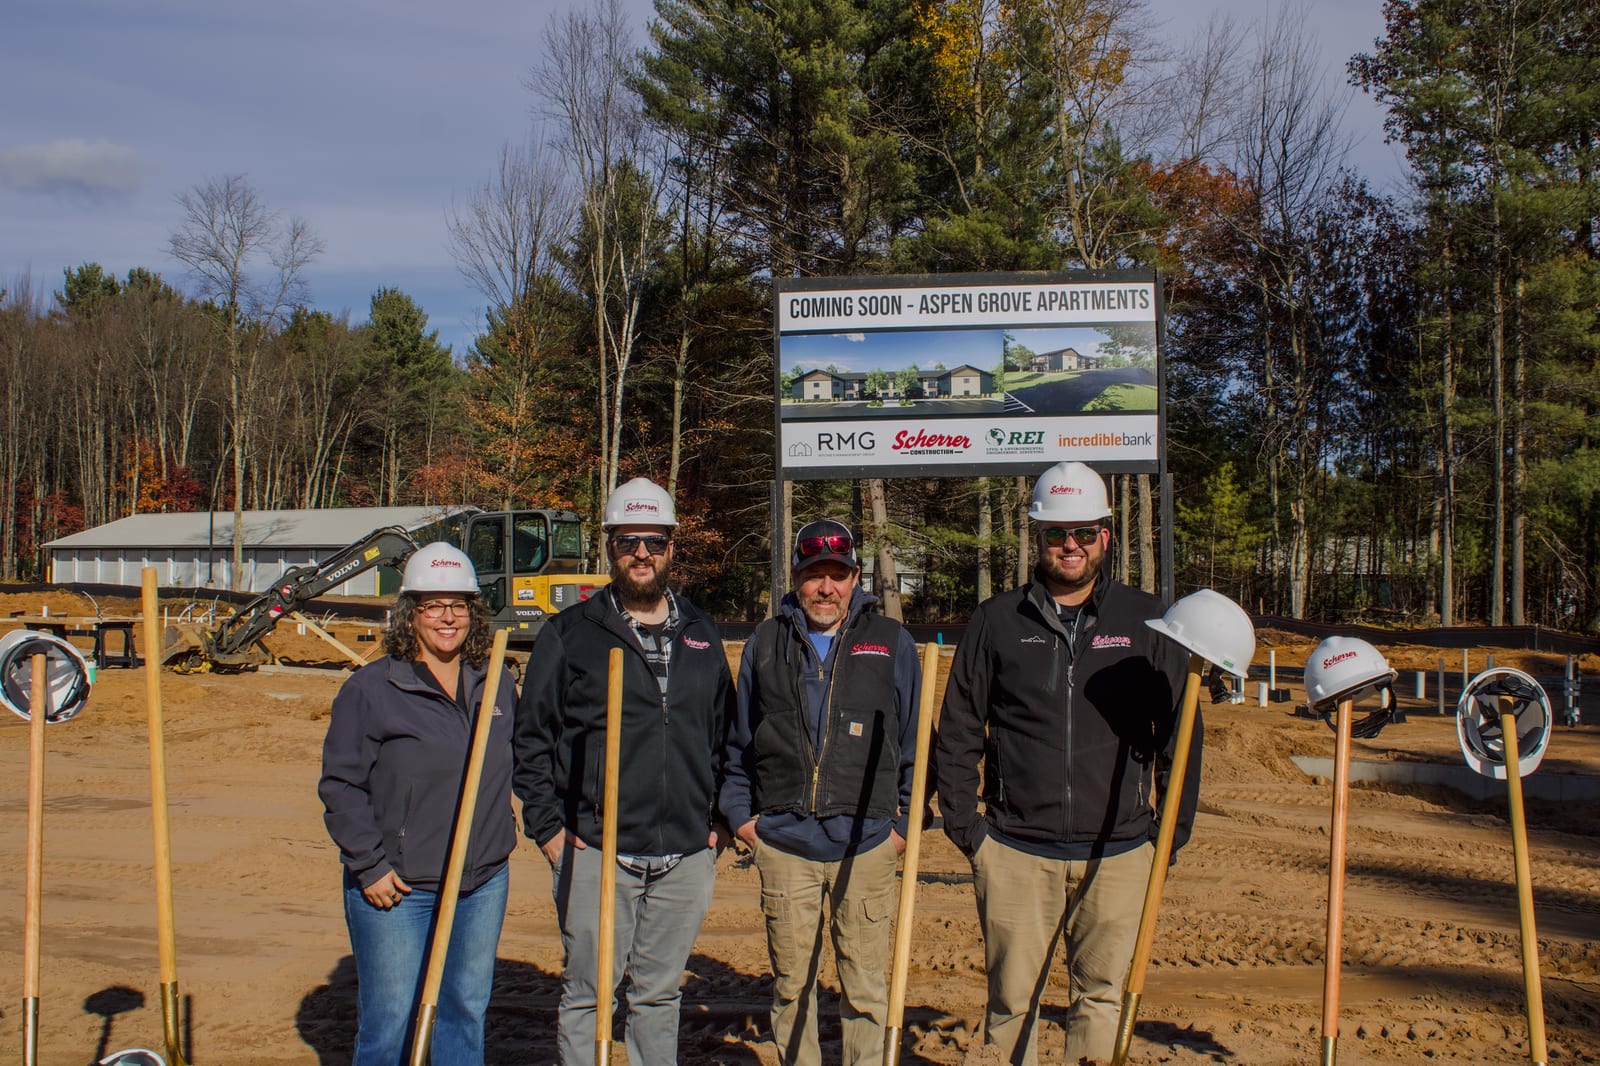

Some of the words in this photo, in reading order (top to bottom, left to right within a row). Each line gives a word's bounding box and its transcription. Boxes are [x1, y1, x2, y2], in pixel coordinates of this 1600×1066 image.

[790, 296, 853, 319] COMING
[858, 295, 902, 316] SOON
[919, 293, 973, 315] ASPEN
[978, 291, 1032, 313] GROVE
[1037, 289, 1149, 311] APARTMENTS
[818, 431, 875, 450] RMG
[892, 428, 972, 450] Scherrer
[1007, 431, 1046, 445] REI
[1058, 432, 1152, 447] incrediblebank
[1050, 485, 1082, 495] Scherr
[326, 559, 360, 582] VOLVO
[1323, 650, 1358, 669] Scherrer
